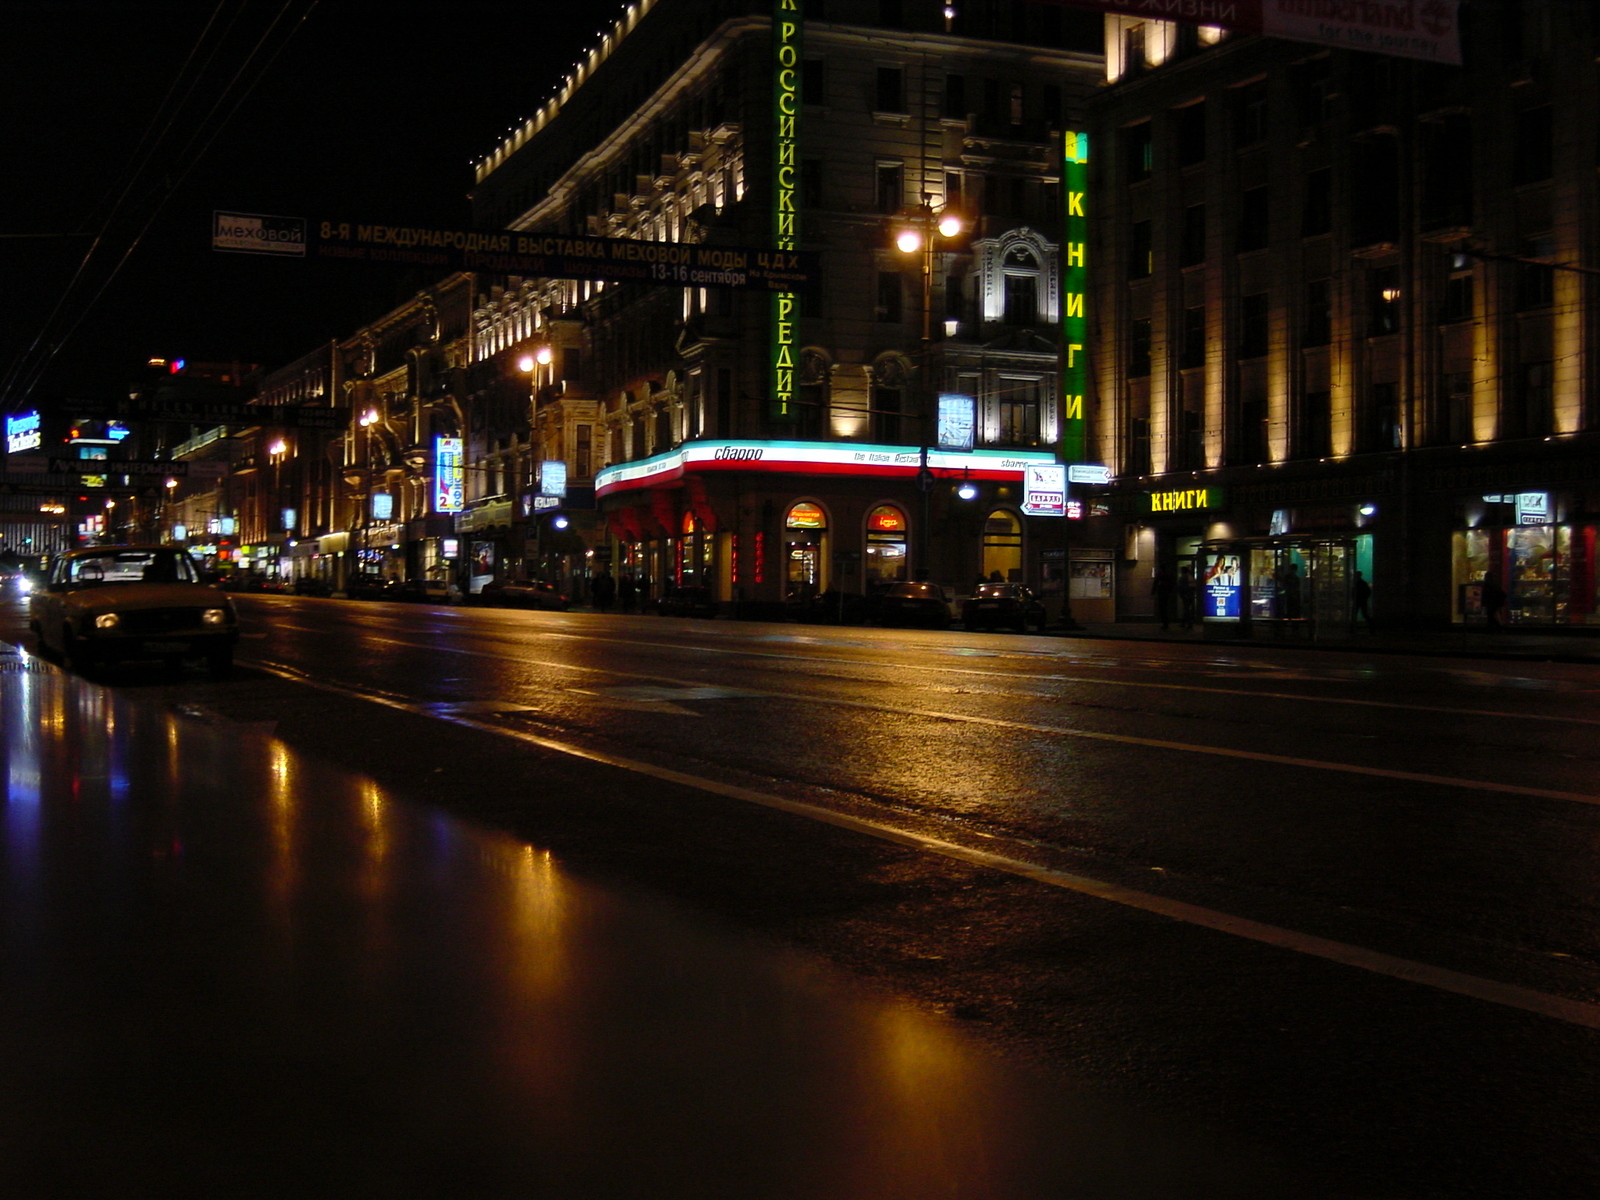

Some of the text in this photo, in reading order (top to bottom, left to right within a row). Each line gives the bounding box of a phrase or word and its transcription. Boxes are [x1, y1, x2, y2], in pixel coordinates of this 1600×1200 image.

[1319, 23, 1439, 54] for the journey
[319, 221, 350, 240] 8-Я
[357, 224, 510, 251] МЕЖДУНАРОДНАЯ
[517, 238, 606, 258] ВЫСТАВКА
[612, 243, 691, 264] МЕХОВОЙ
[698, 250, 747, 269] МОДЫ
[463, 251, 545, 271] ПРОДАЖИ
[564, 261, 646, 278] ШОУ-ПОКАЗЫ
[651, 263, 746, 287] 13-16 сентября
[1066, 191, 1084, 420] КНИГИ
[776, 292, 795, 414] РЕДИТ
[714, 445, 764, 462] сбарро
[853, 452, 866, 461] the
[1000, 458, 1029, 469] sbarr
[1151, 489, 1208, 512] КНИГИ
